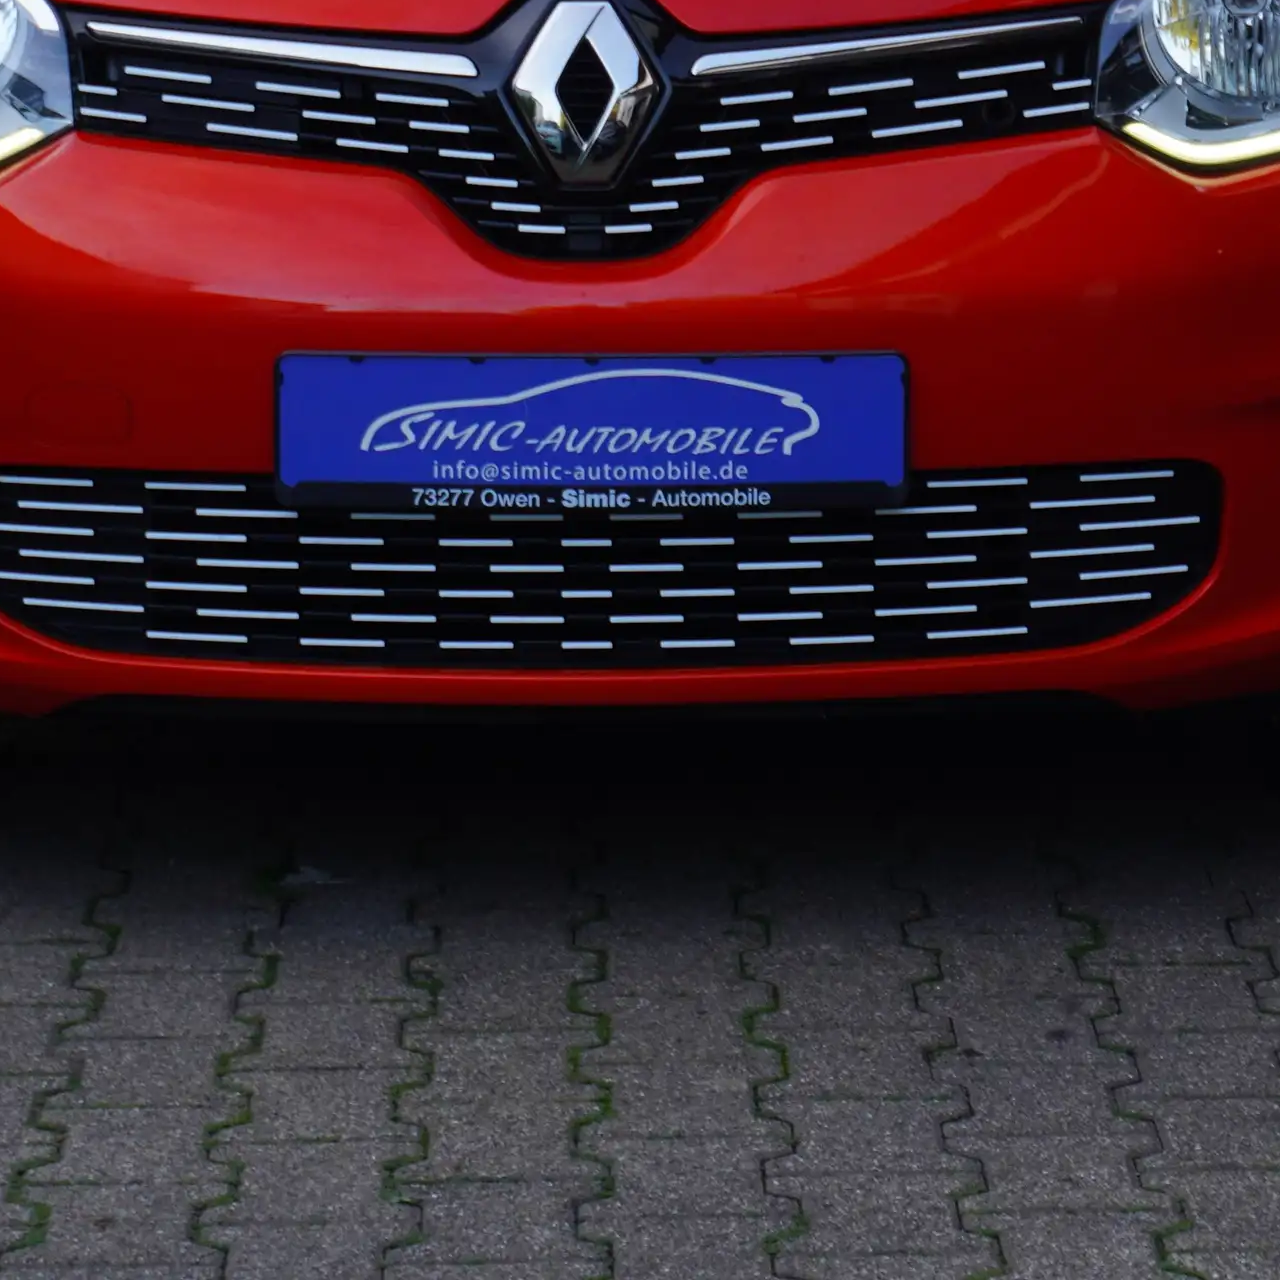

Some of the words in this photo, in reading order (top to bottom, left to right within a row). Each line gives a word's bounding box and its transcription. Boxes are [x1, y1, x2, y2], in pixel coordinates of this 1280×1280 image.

[373, 411, 784, 455] SIMIC-AUTOMOBILE
[432, 459, 749, 482] info@simic-automobile.de
[412, 488, 474, 507] 73277
[480, 489, 540, 508] Owen
[561, 488, 631, 509] Simic
[651, 487, 772, 508] Automobile
